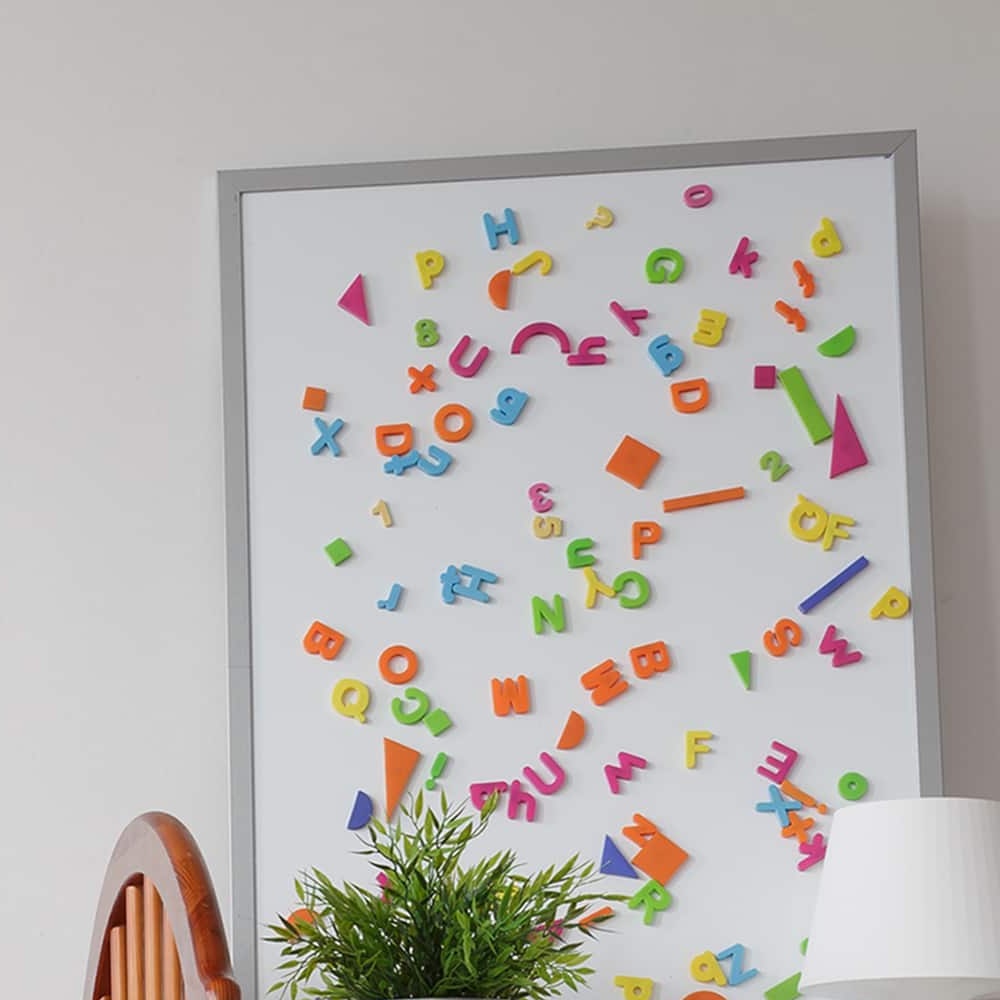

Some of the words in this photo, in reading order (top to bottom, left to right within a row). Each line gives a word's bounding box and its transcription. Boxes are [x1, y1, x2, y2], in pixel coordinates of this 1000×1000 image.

[483, 208, 519, 250] H
[632, 521, 663, 560] P
[531, 594, 565, 635] N
[303, 621, 345, 661] B
[763, 618, 803, 657] S
[629, 641, 671, 680] B
[332, 679, 370, 723] Q
[686, 731, 713, 769] F
[757, 740, 799, 785] E
[508, 780, 537, 823] h
[628, 880, 673, 925] R
